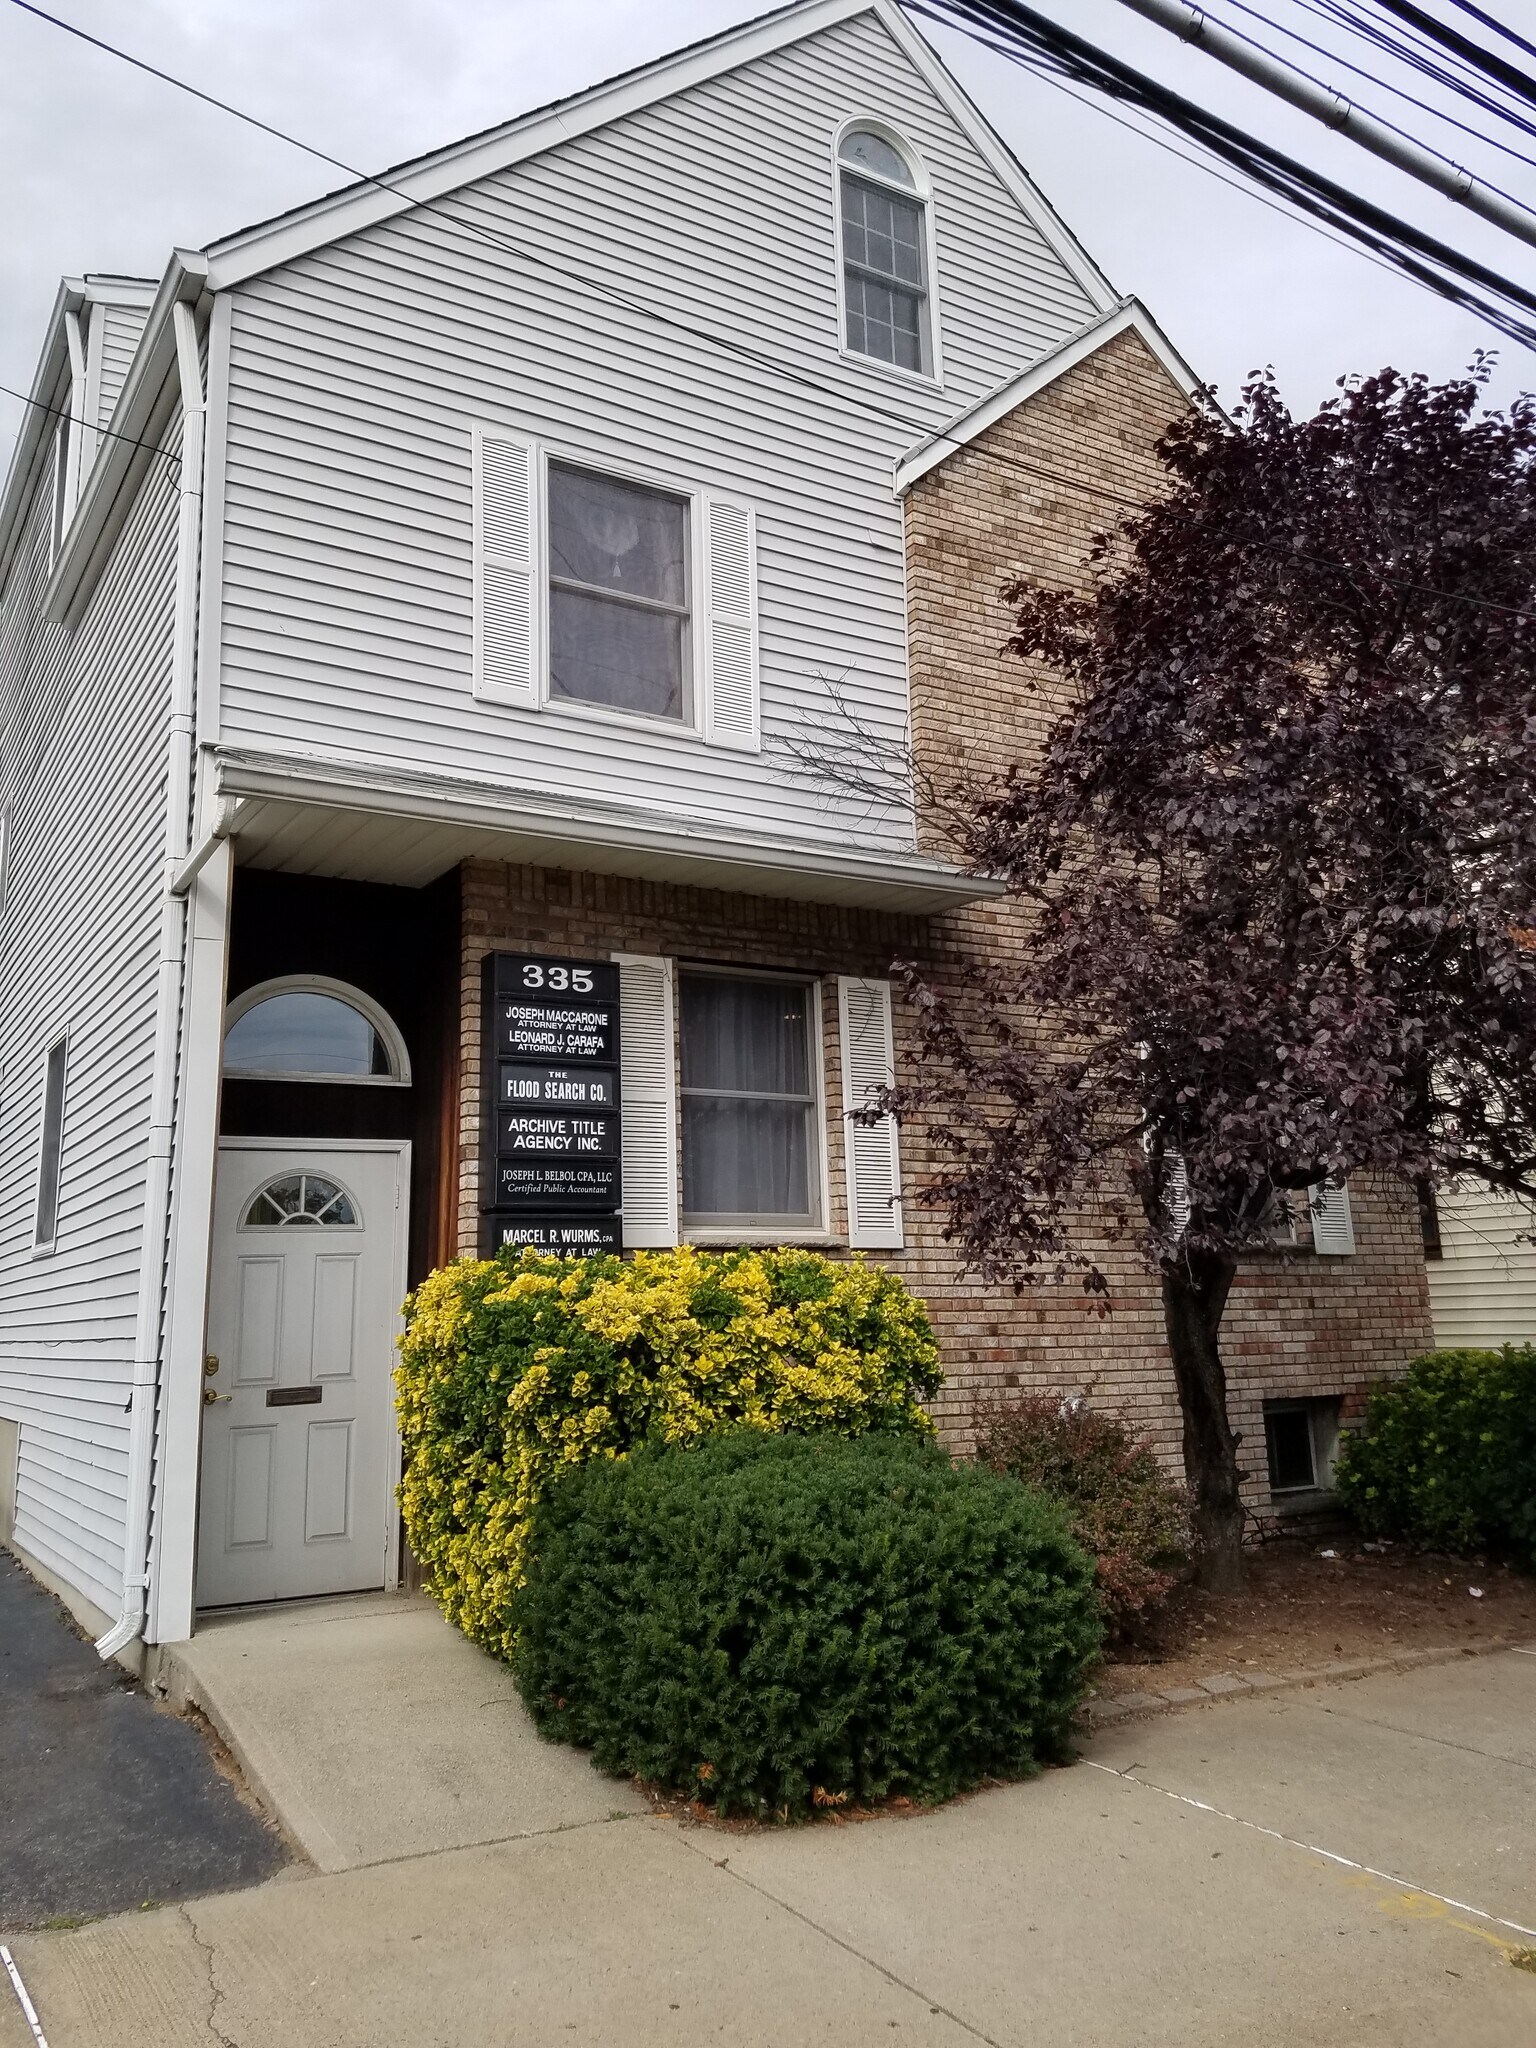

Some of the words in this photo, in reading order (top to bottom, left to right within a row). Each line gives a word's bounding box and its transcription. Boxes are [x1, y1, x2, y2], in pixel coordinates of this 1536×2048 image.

[522, 965, 594, 993] 335
[506, 1006, 544, 1020] JOSEPH
[546, 1010, 608, 1026] MACCARONE
[518, 1020, 563, 1030] ATTORNEY
[509, 1030, 554, 1044] LEONARD
[557, 1035, 564, 1045] J.
[567, 1035, 604, 1048] CARAFA
[518, 1044, 563, 1053] ATTORNEY
[507, 1080, 539, 1098] FLOOD
[545, 1082, 585, 1100] SEARCH
[591, 1084, 606, 1101] CO.
[508, 1119, 566, 1133] ARCHIVE
[571, 1121, 605, 1135] TITLE
[514, 1135, 572, 1149] AGENCY
[578, 1137, 601, 1150] INC.
[502, 1170, 534, 1182] JOSEPH
[536, 1171, 543, 1180] L.
[545, 1171, 575, 1181] BELBOL
[577, 1172, 596, 1183] CPA,
[598, 1172, 612, 1182] LLC
[508, 1184, 541, 1195] Certified
[543, 1185, 565, 1193] Public
[567, 1185, 607, 1194] Accountant
[503, 1229, 546, 1243] MARCEL
[550, 1230, 559, 1243] R.
[561, 1229, 601, 1244] WURMS,
[566, 1248, 577, 1256] AT
[582, 1248, 601, 1256] LAW
